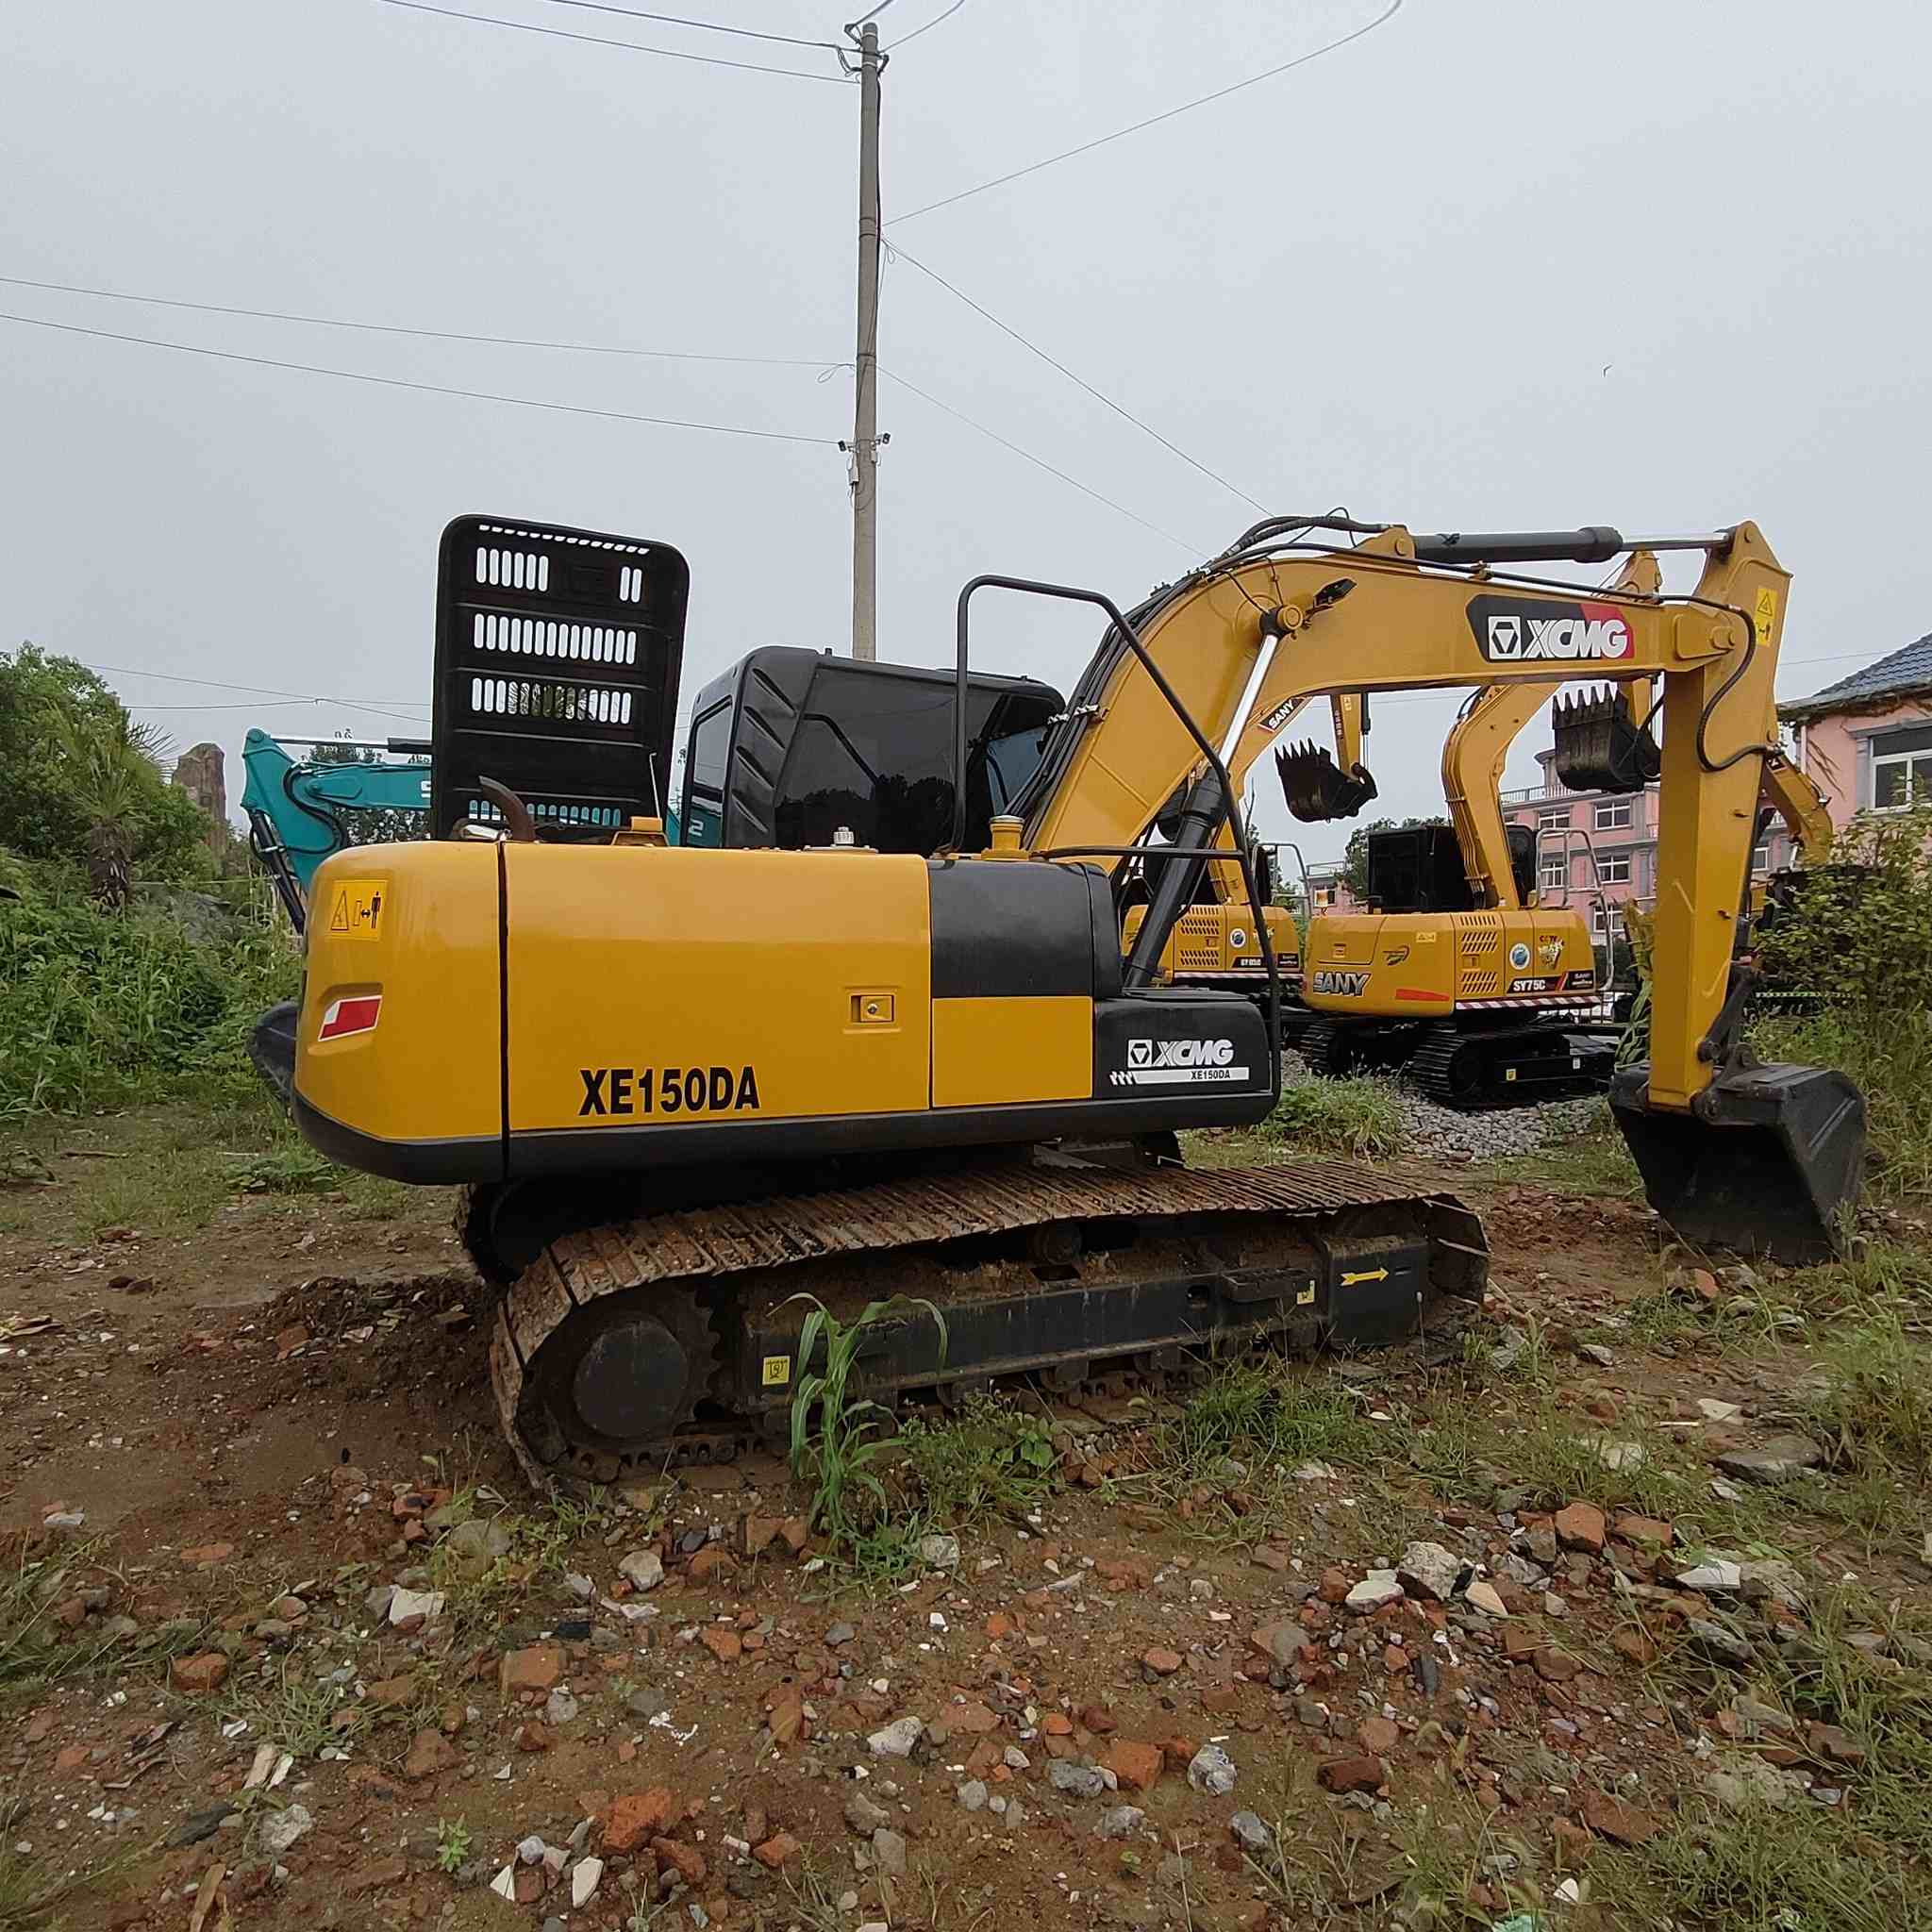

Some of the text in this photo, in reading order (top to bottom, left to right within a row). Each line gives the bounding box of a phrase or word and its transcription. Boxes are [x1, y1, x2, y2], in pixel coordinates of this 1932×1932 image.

[1523, 619, 1628, 658] XCMG
[1268, 699, 1294, 729] SANY
[1313, 972, 1370, 996] SANY
[1513, 979, 1546, 991] SY75C
[1152, 1040, 1234, 1067] XCMG
[1191, 1069, 1231, 1080] XE150DA
[579, 1066, 760, 1116] XE150DA
